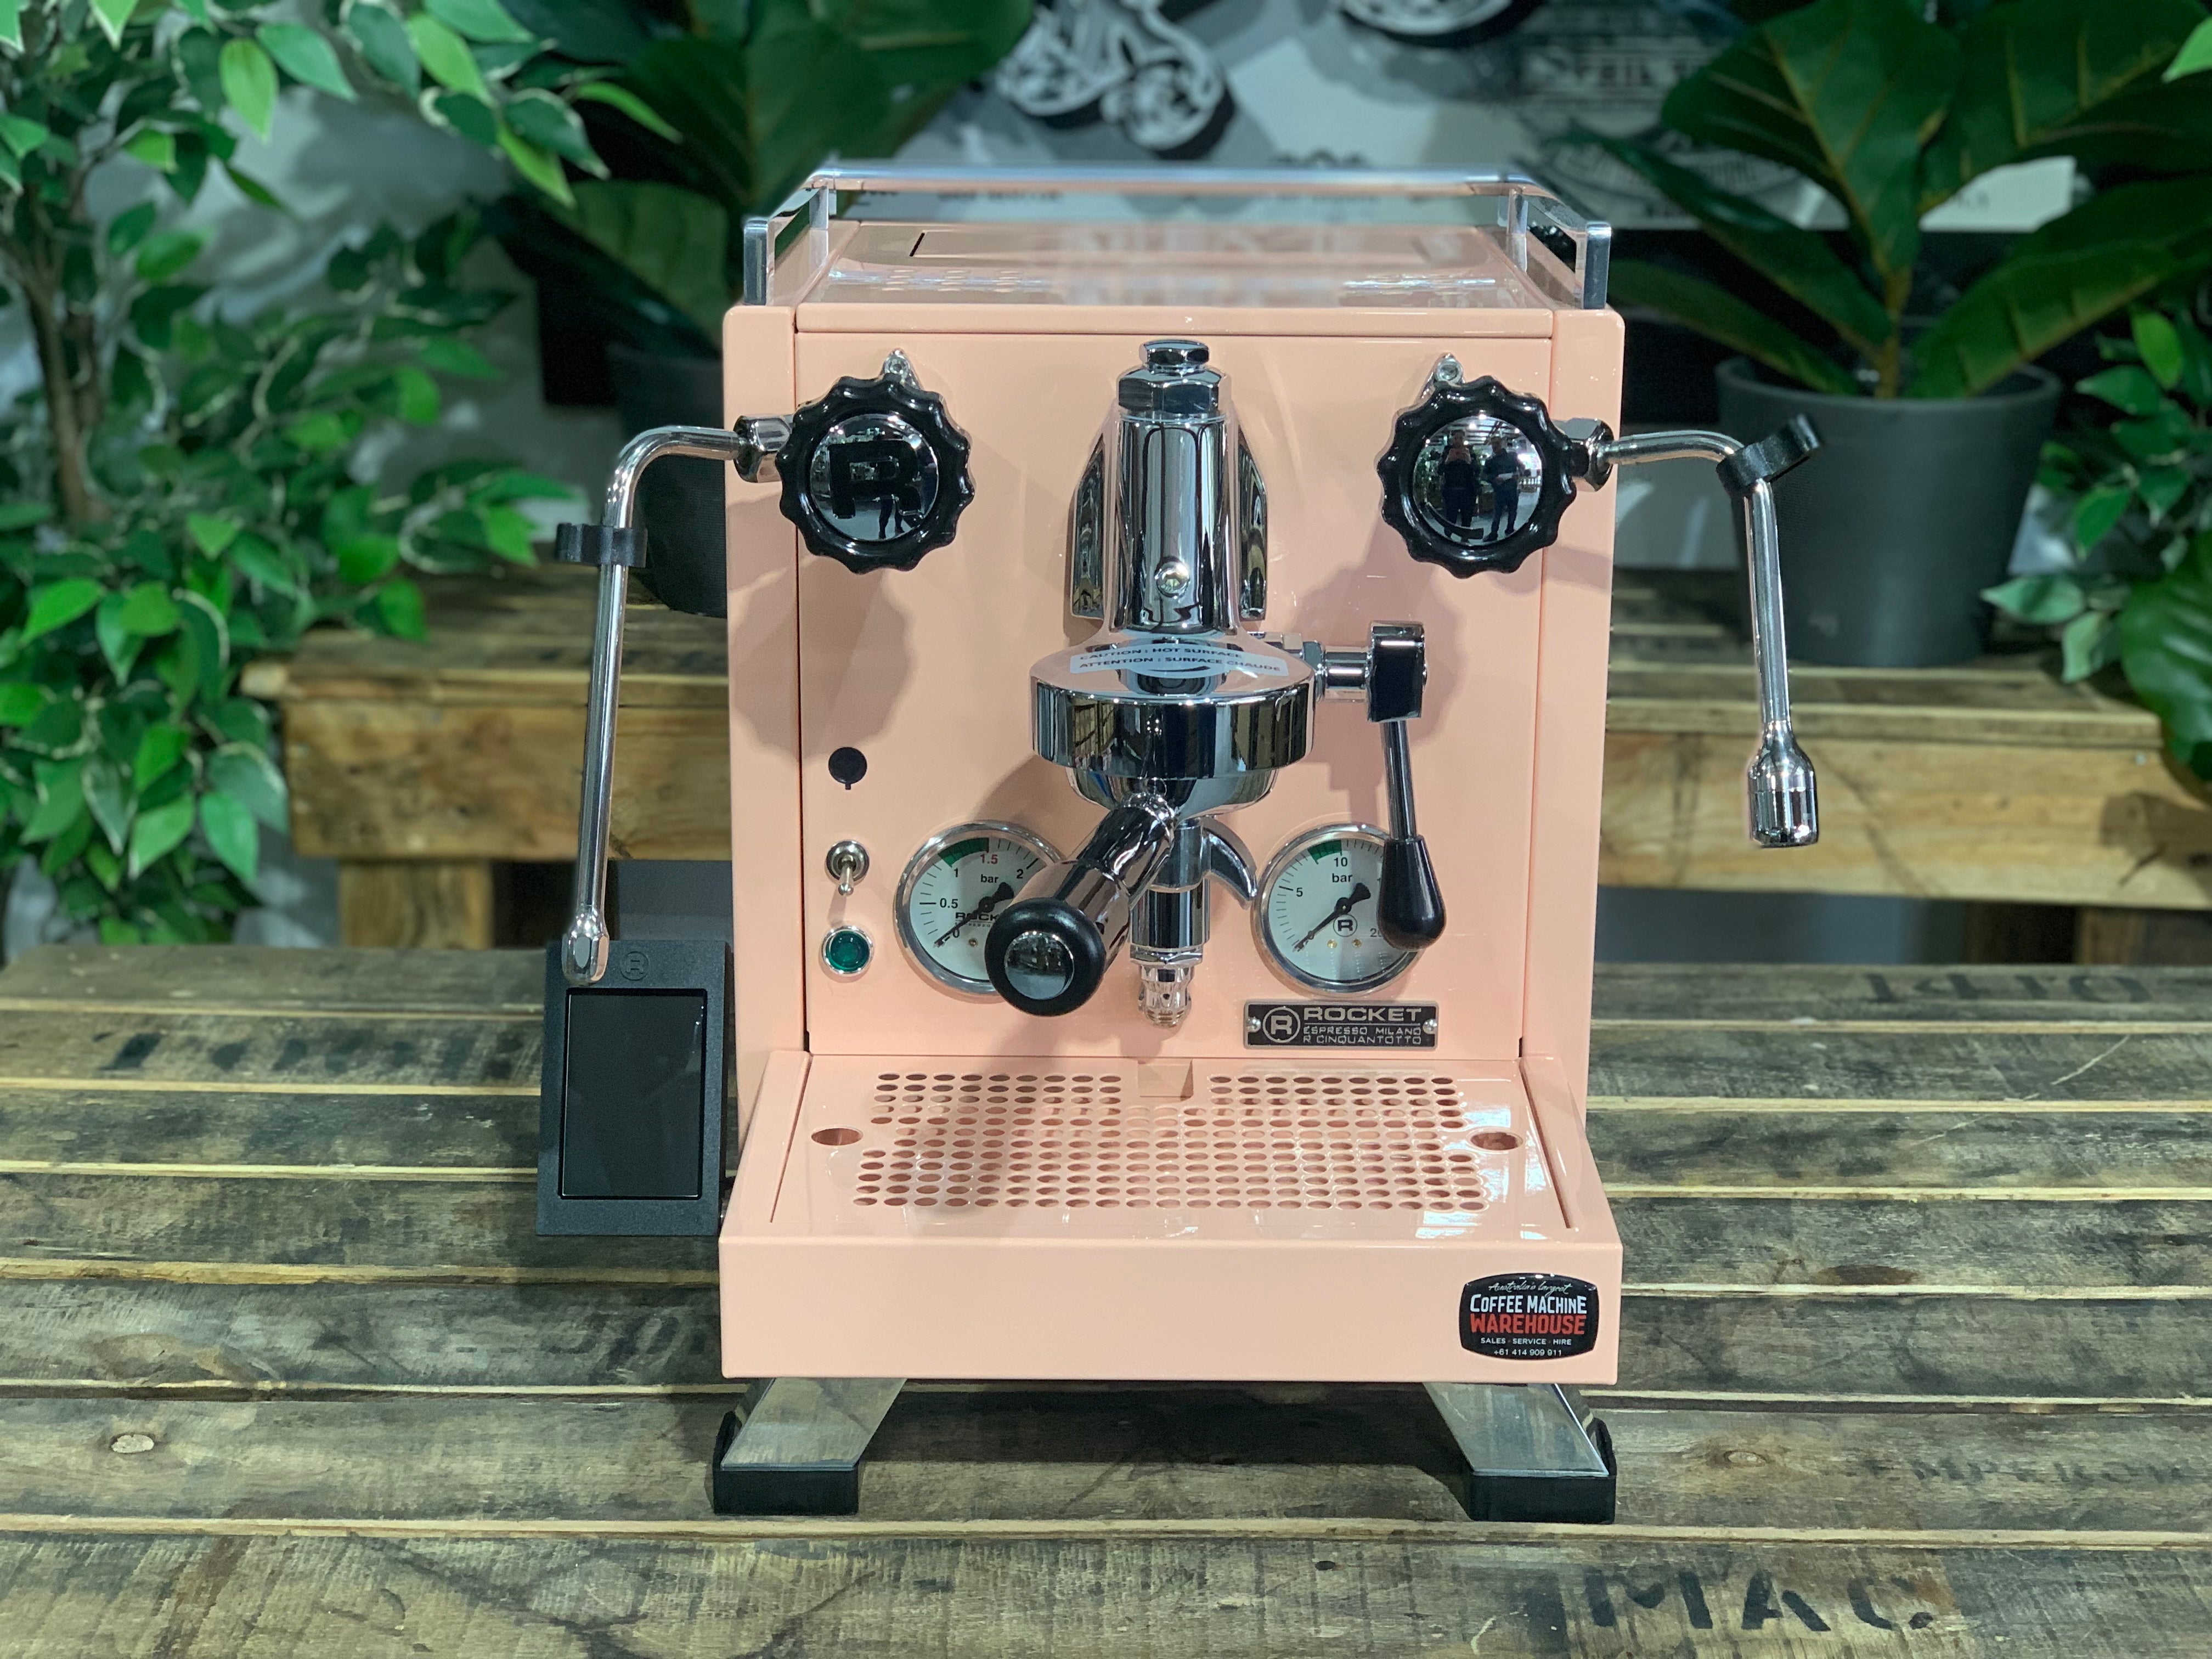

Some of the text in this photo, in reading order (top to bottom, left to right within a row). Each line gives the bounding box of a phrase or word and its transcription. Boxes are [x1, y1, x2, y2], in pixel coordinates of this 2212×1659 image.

[1080, 650, 1141, 659] CAUTION
[1184, 648, 1242, 658] SURFACE
[1080, 658, 1153, 668] ATTENTION
[1226, 661, 1280, 671] CHAUDE
[980, 854, 998, 865] 1.5
[1334, 857, 1348, 867] 10
[954, 868, 958, 877] 1
[1016, 869, 1023, 879] 2
[1332, 873, 1353, 883] bar
[980, 874, 998, 883] bar
[1296, 888, 1303, 897] 5
[940, 898, 958, 909] 0.5
[1338, 919, 1353, 932] R
[1304, 1007, 1421, 1022] ROCKET
[1271, 1015, 1292, 1035] R
[1304, 1026, 1421, 1035] ESPRESSO MILANO
[1304, 1035, 1421, 1045] R CINQUANTOTTO
[1488, 1280, 1536, 1293] Australia's
[1470, 1294, 1587, 1314] COFFEE MACHINE
[1470, 1313, 1587, 1334] WAREHOUSE
